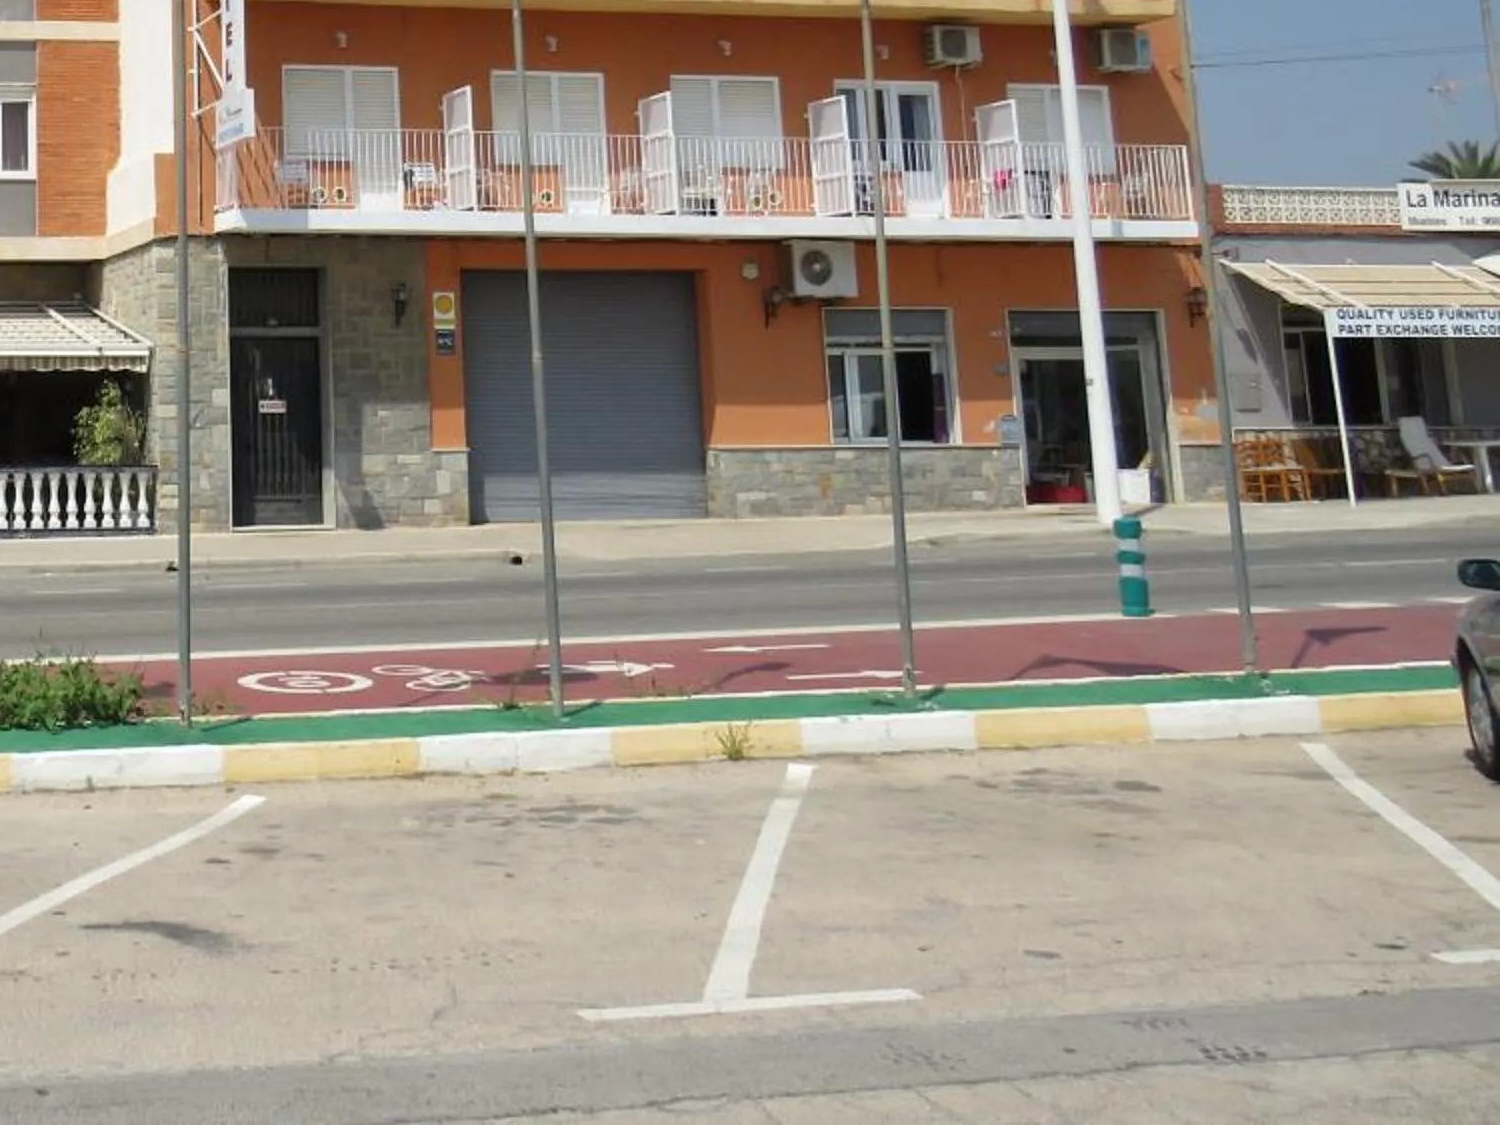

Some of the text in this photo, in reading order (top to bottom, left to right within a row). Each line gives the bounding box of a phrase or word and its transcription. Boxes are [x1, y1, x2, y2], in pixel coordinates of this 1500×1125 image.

[1407, 188, 1500, 208] La Marina
[1337, 309, 1393, 320] QUALITY
[1399, 309, 1434, 320] USED
[1338, 325, 1373, 336] PART
[1376, 325, 1446, 336] EXCHANGE
